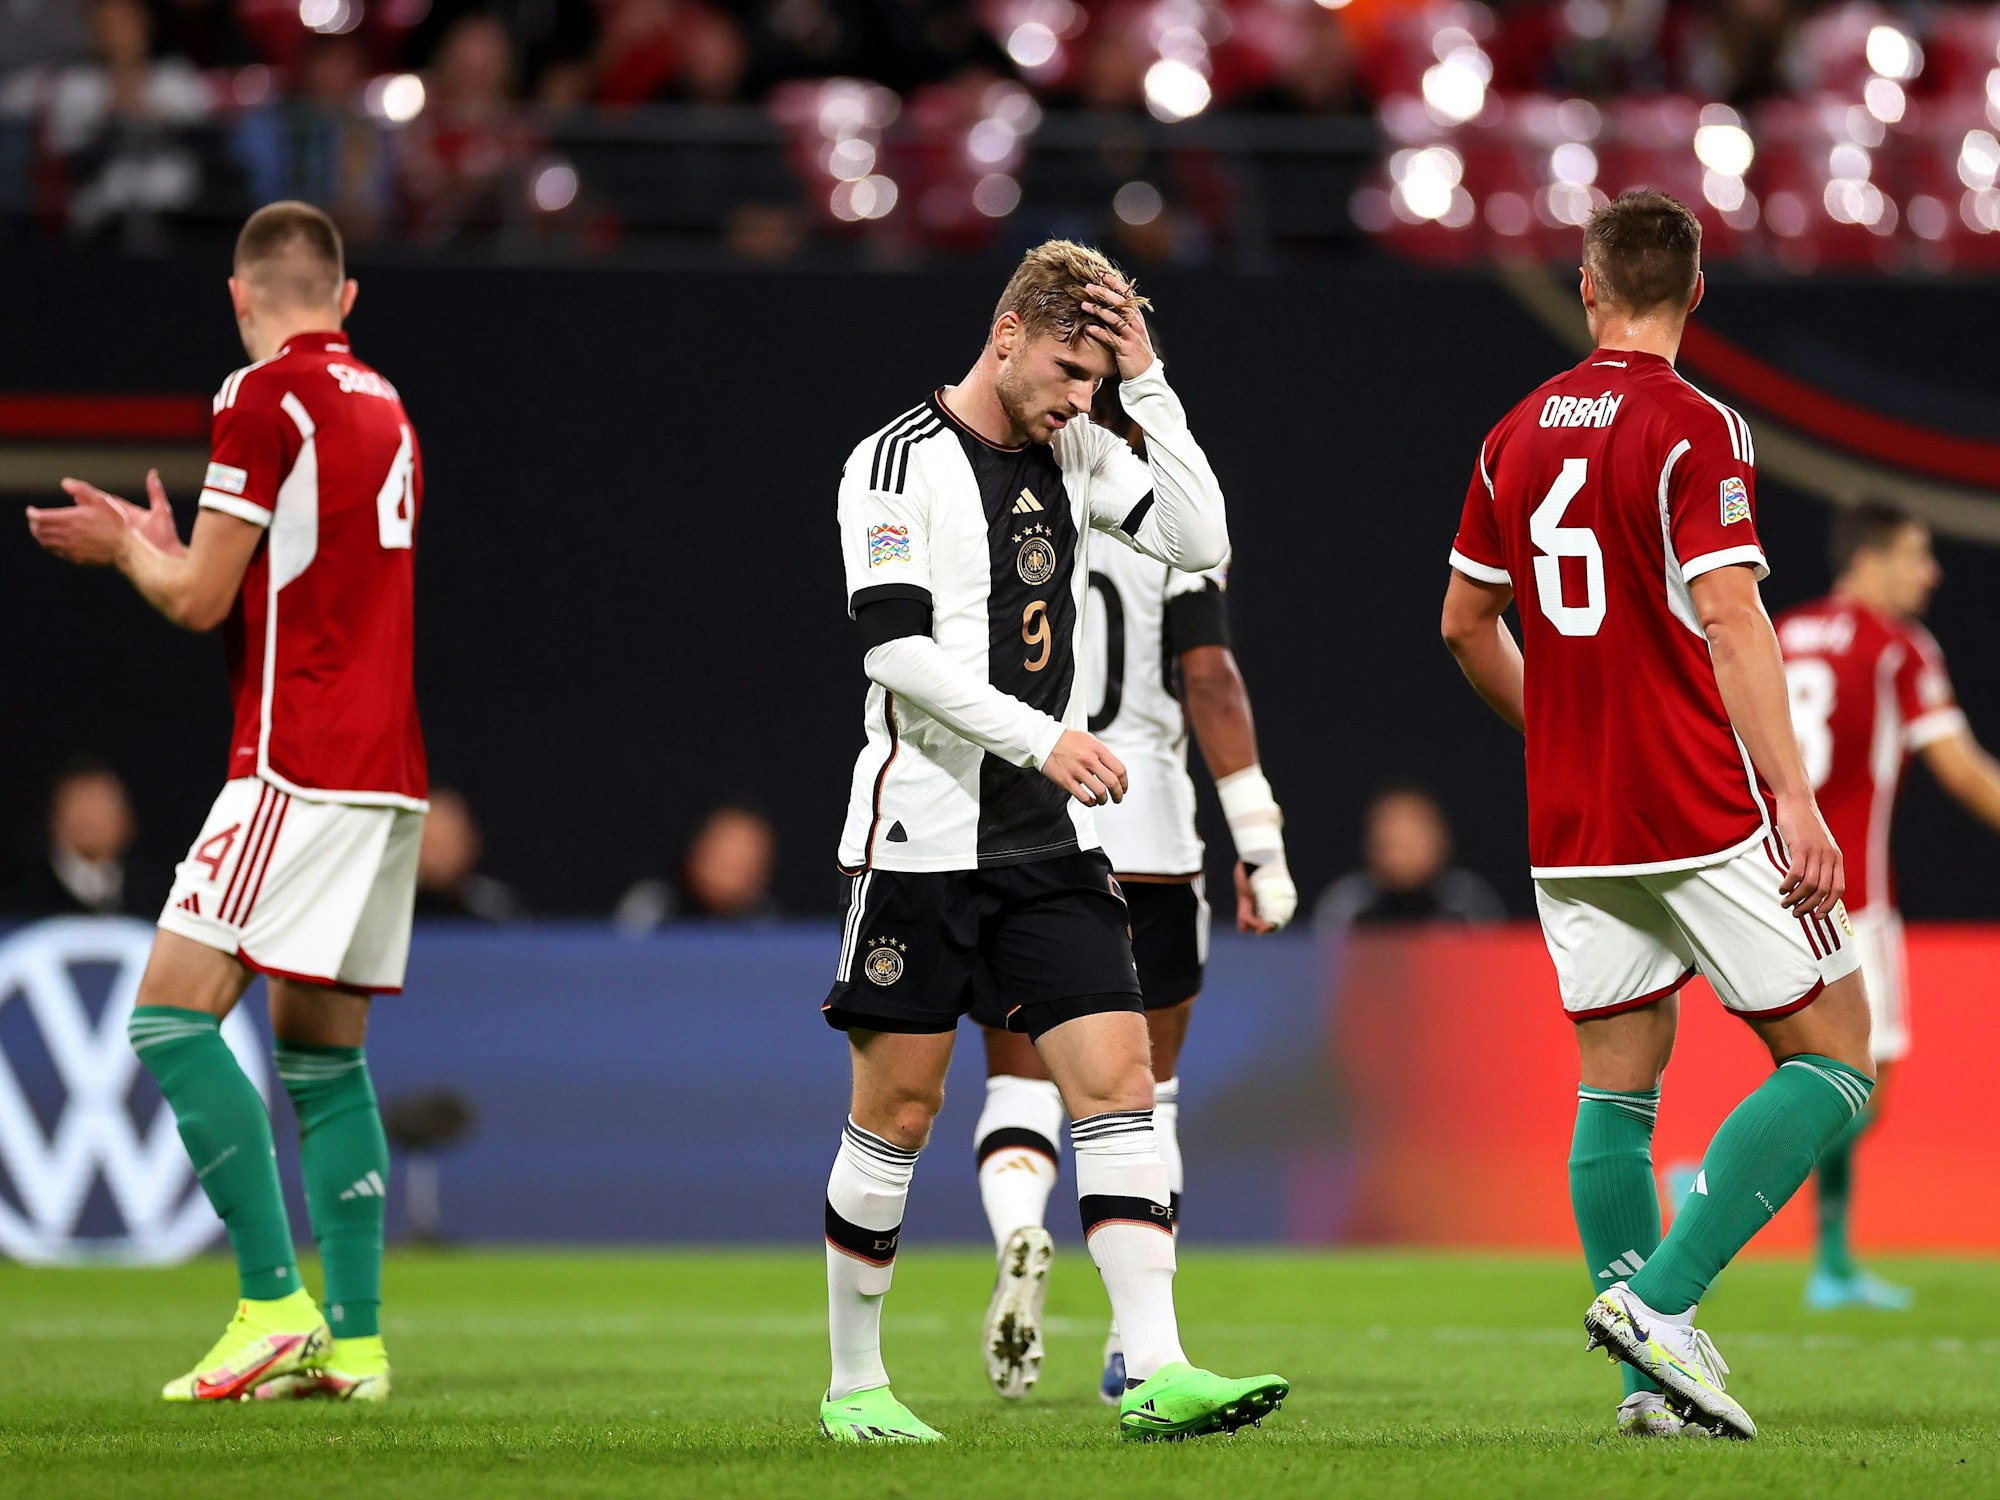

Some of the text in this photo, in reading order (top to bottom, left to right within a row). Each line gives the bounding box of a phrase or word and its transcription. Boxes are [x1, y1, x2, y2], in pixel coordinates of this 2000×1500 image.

[1539, 390, 1624, 428] ORBÁN
[1529, 458, 1607, 636] 6
[1022, 601, 1052, 672] 9
[196, 823, 241, 881] 4
